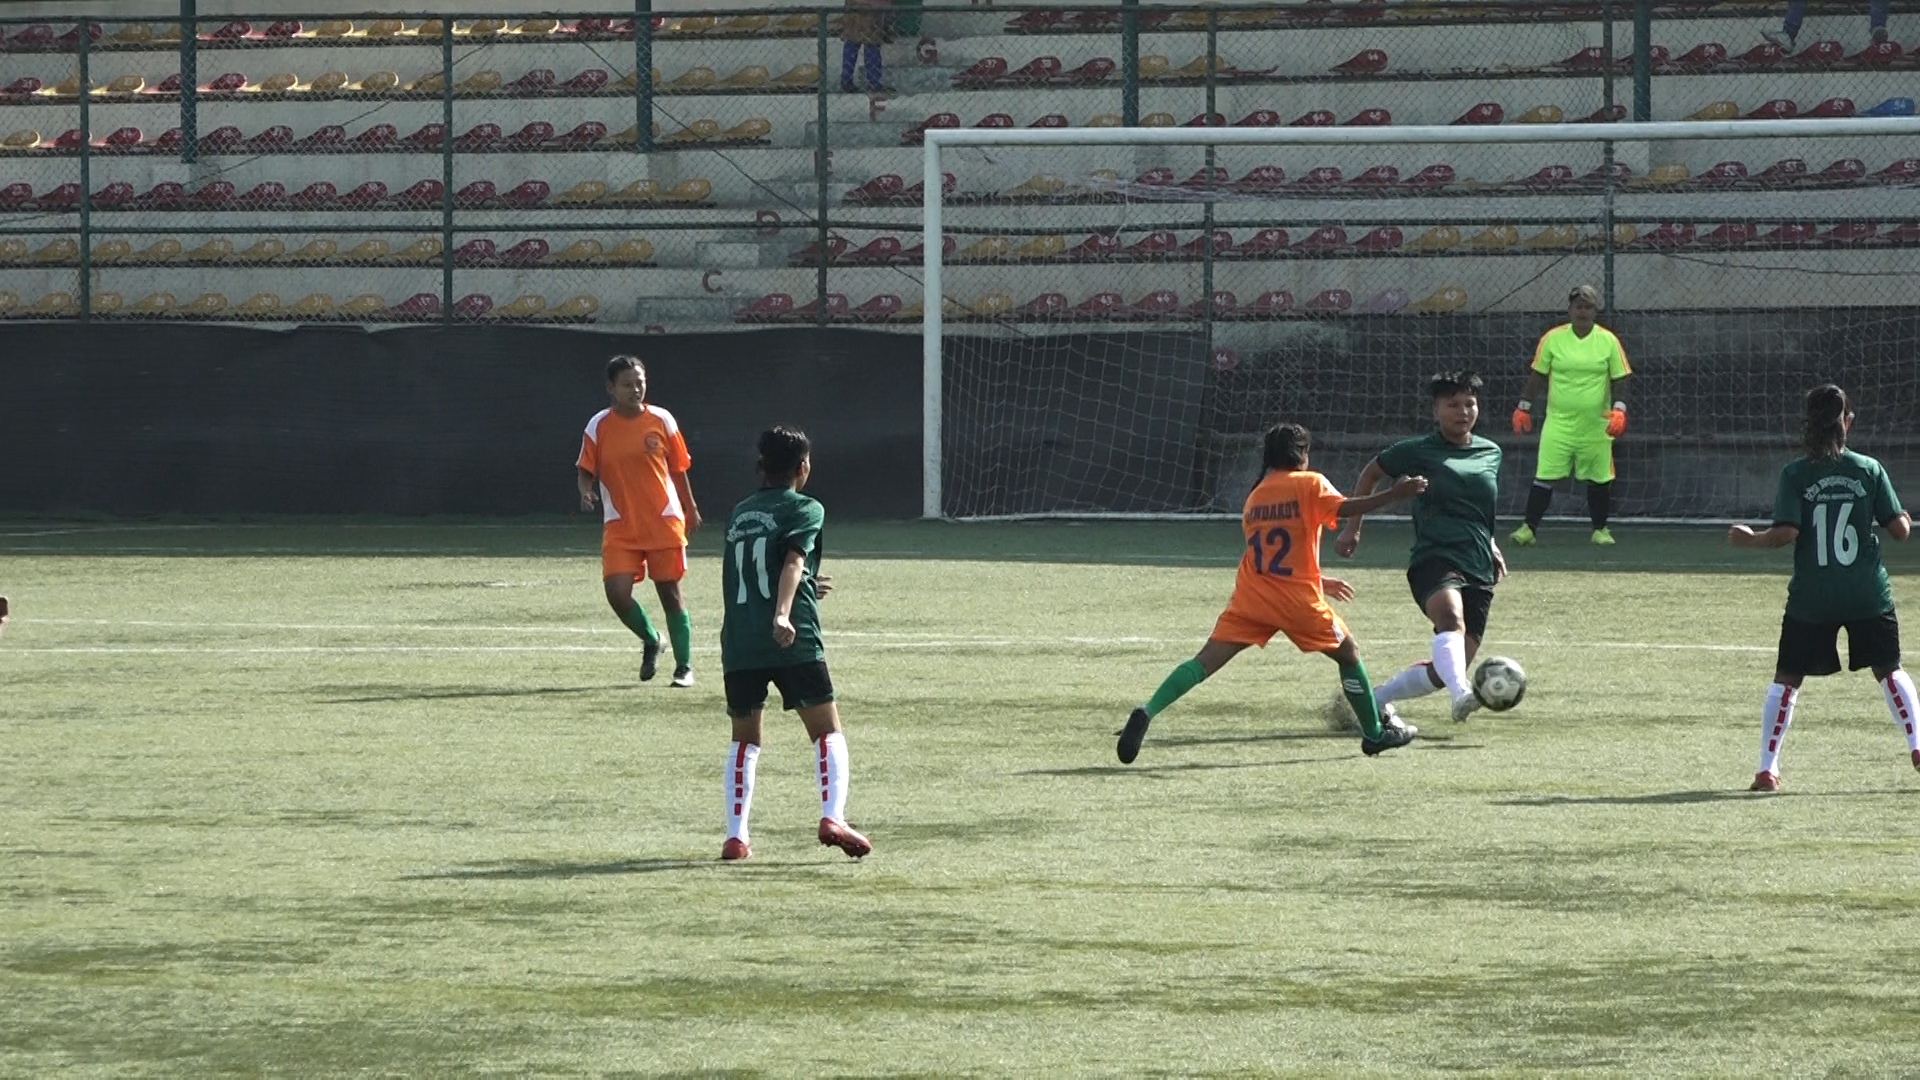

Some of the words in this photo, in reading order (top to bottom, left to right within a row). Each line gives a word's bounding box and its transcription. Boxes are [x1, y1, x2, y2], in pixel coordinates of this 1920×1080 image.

[917, 37, 938, 65] G
[702, 269, 723, 293] C
[1248, 527, 1293, 576] 12
[1812, 503, 1859, 566] 16
[735, 537, 771, 605] 11
